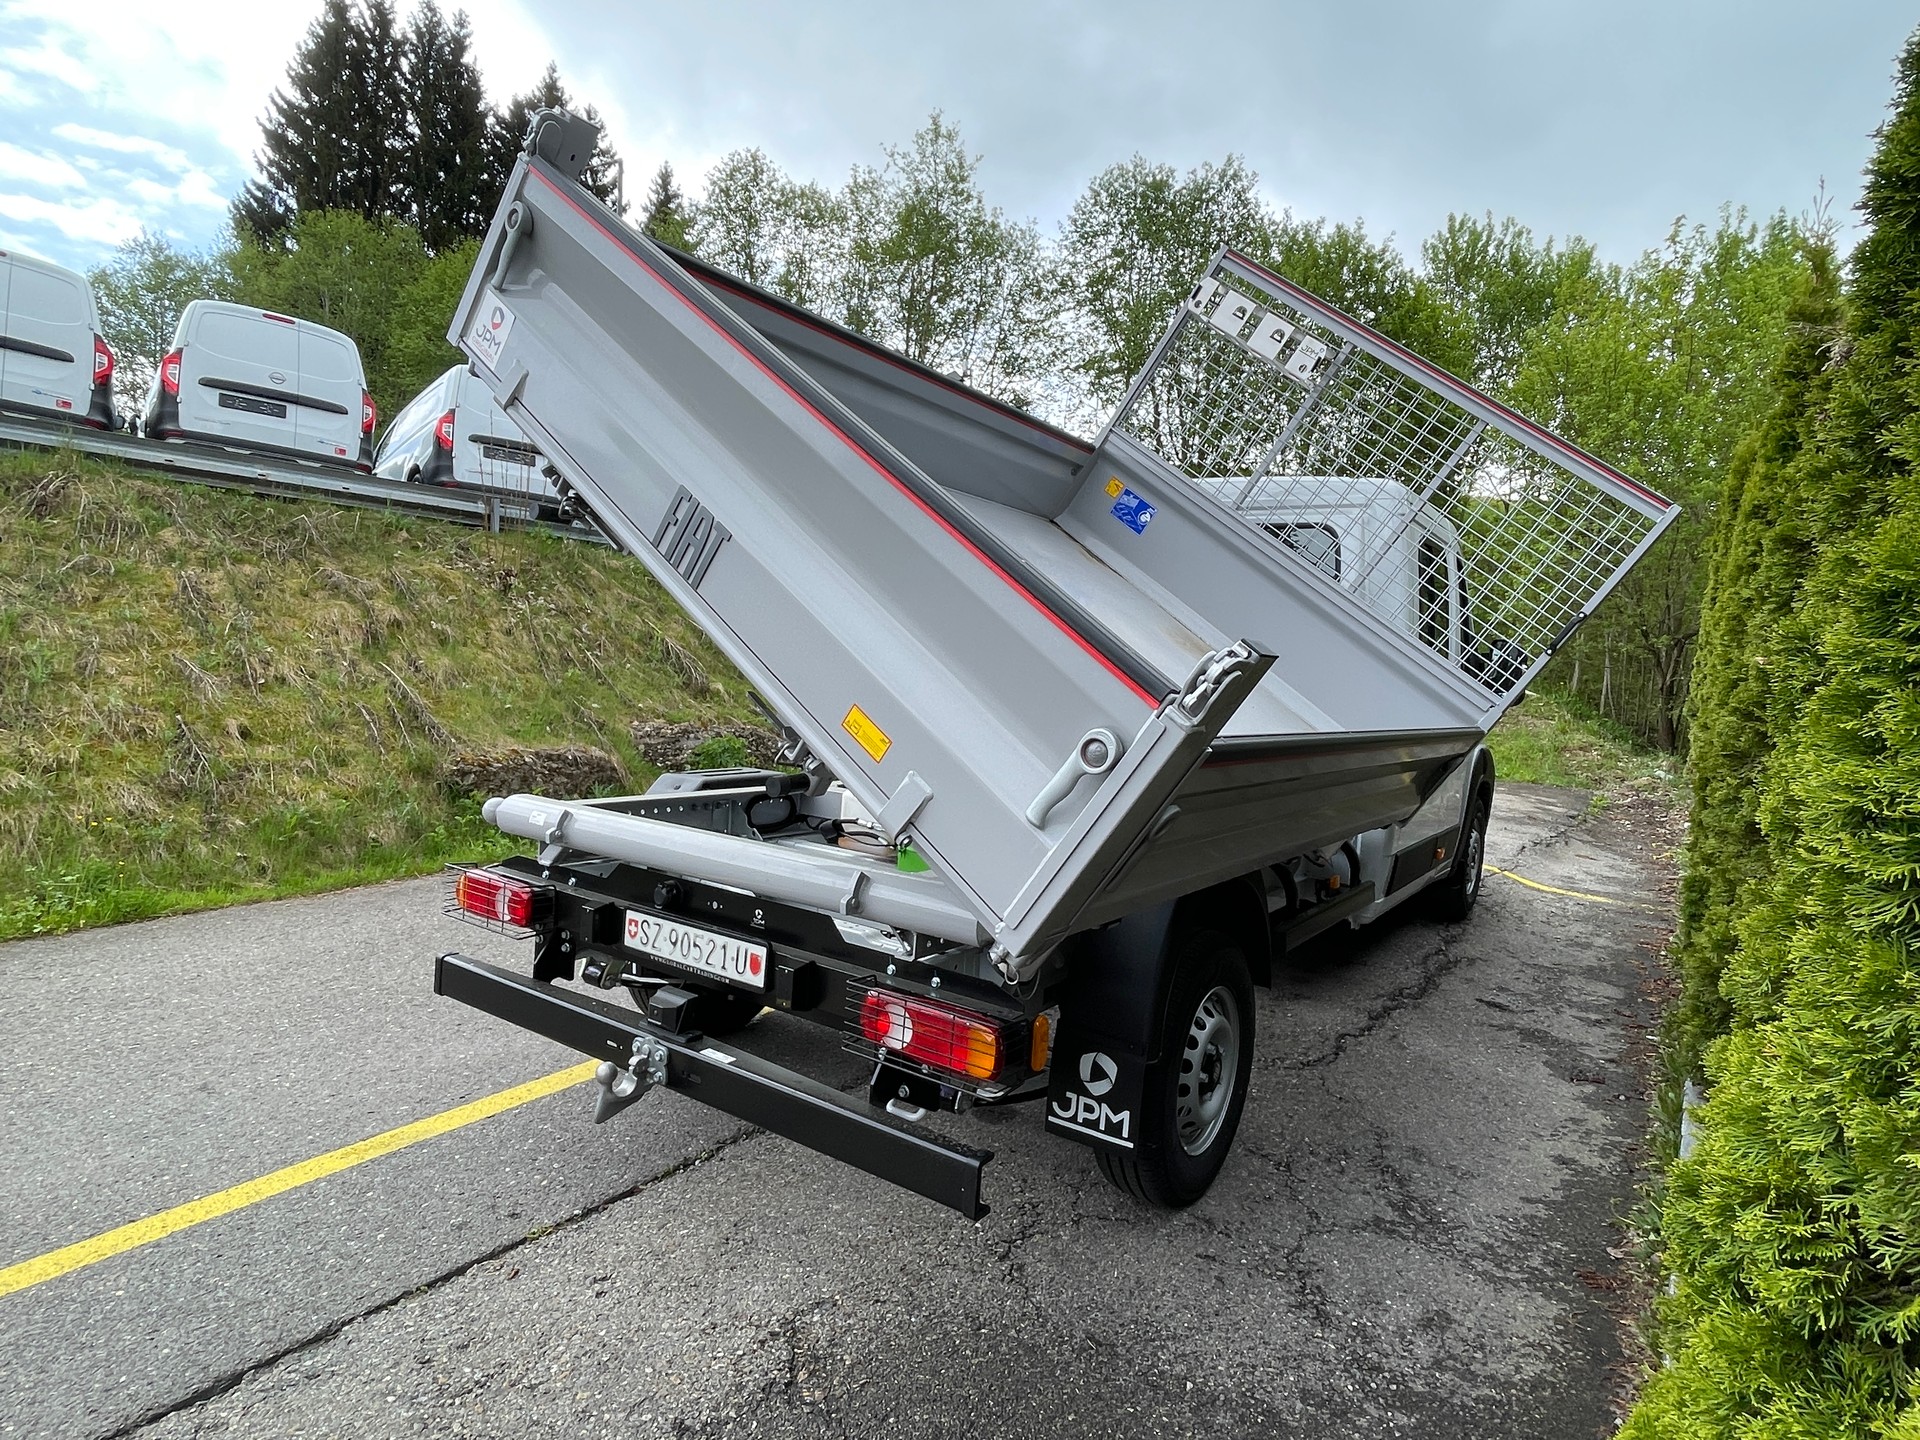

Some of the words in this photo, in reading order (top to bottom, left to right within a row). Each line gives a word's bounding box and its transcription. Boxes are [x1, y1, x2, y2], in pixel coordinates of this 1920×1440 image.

[475, 324, 502, 356] JPM
[651, 483, 734, 591] FIAT
[1052, 1091, 1131, 1138] JPM
